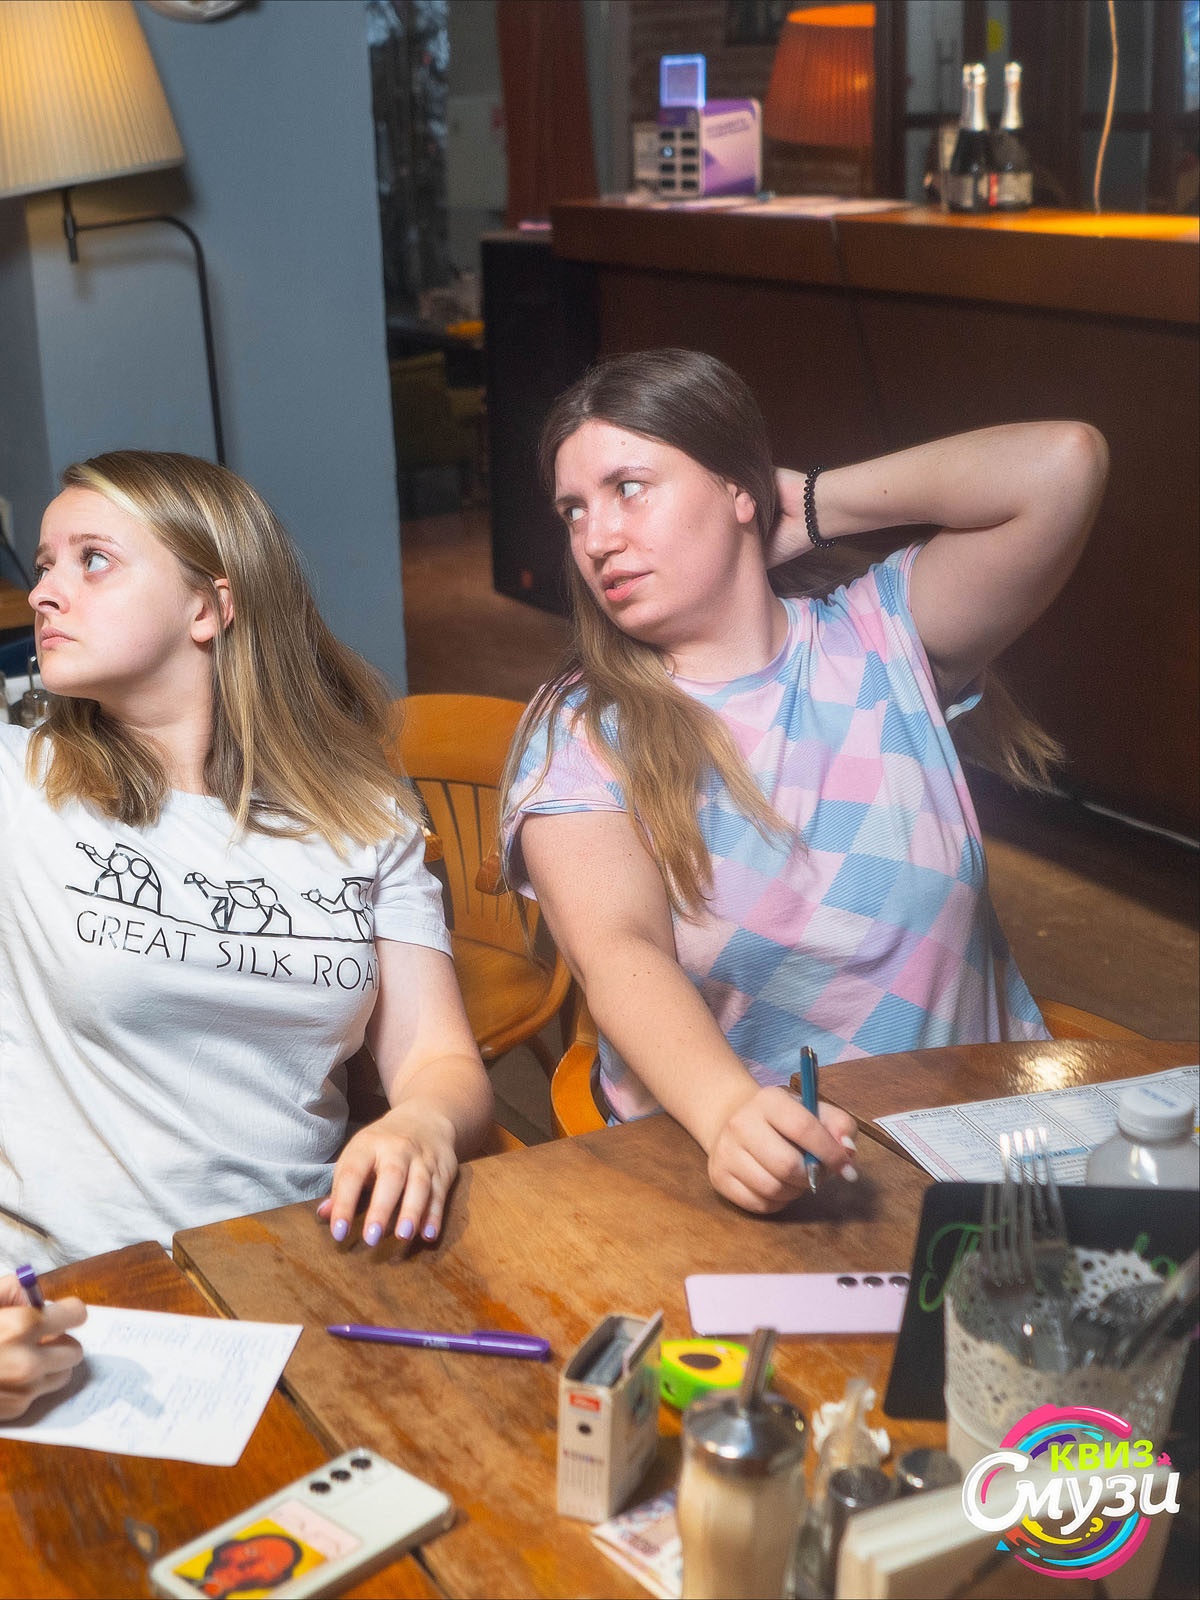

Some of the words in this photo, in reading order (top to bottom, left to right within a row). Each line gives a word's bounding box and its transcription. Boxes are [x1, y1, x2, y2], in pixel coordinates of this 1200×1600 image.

[76, 910, 197, 961] GREAT
[216, 940, 293, 978] SILK
[312, 954, 378, 991] ROA
